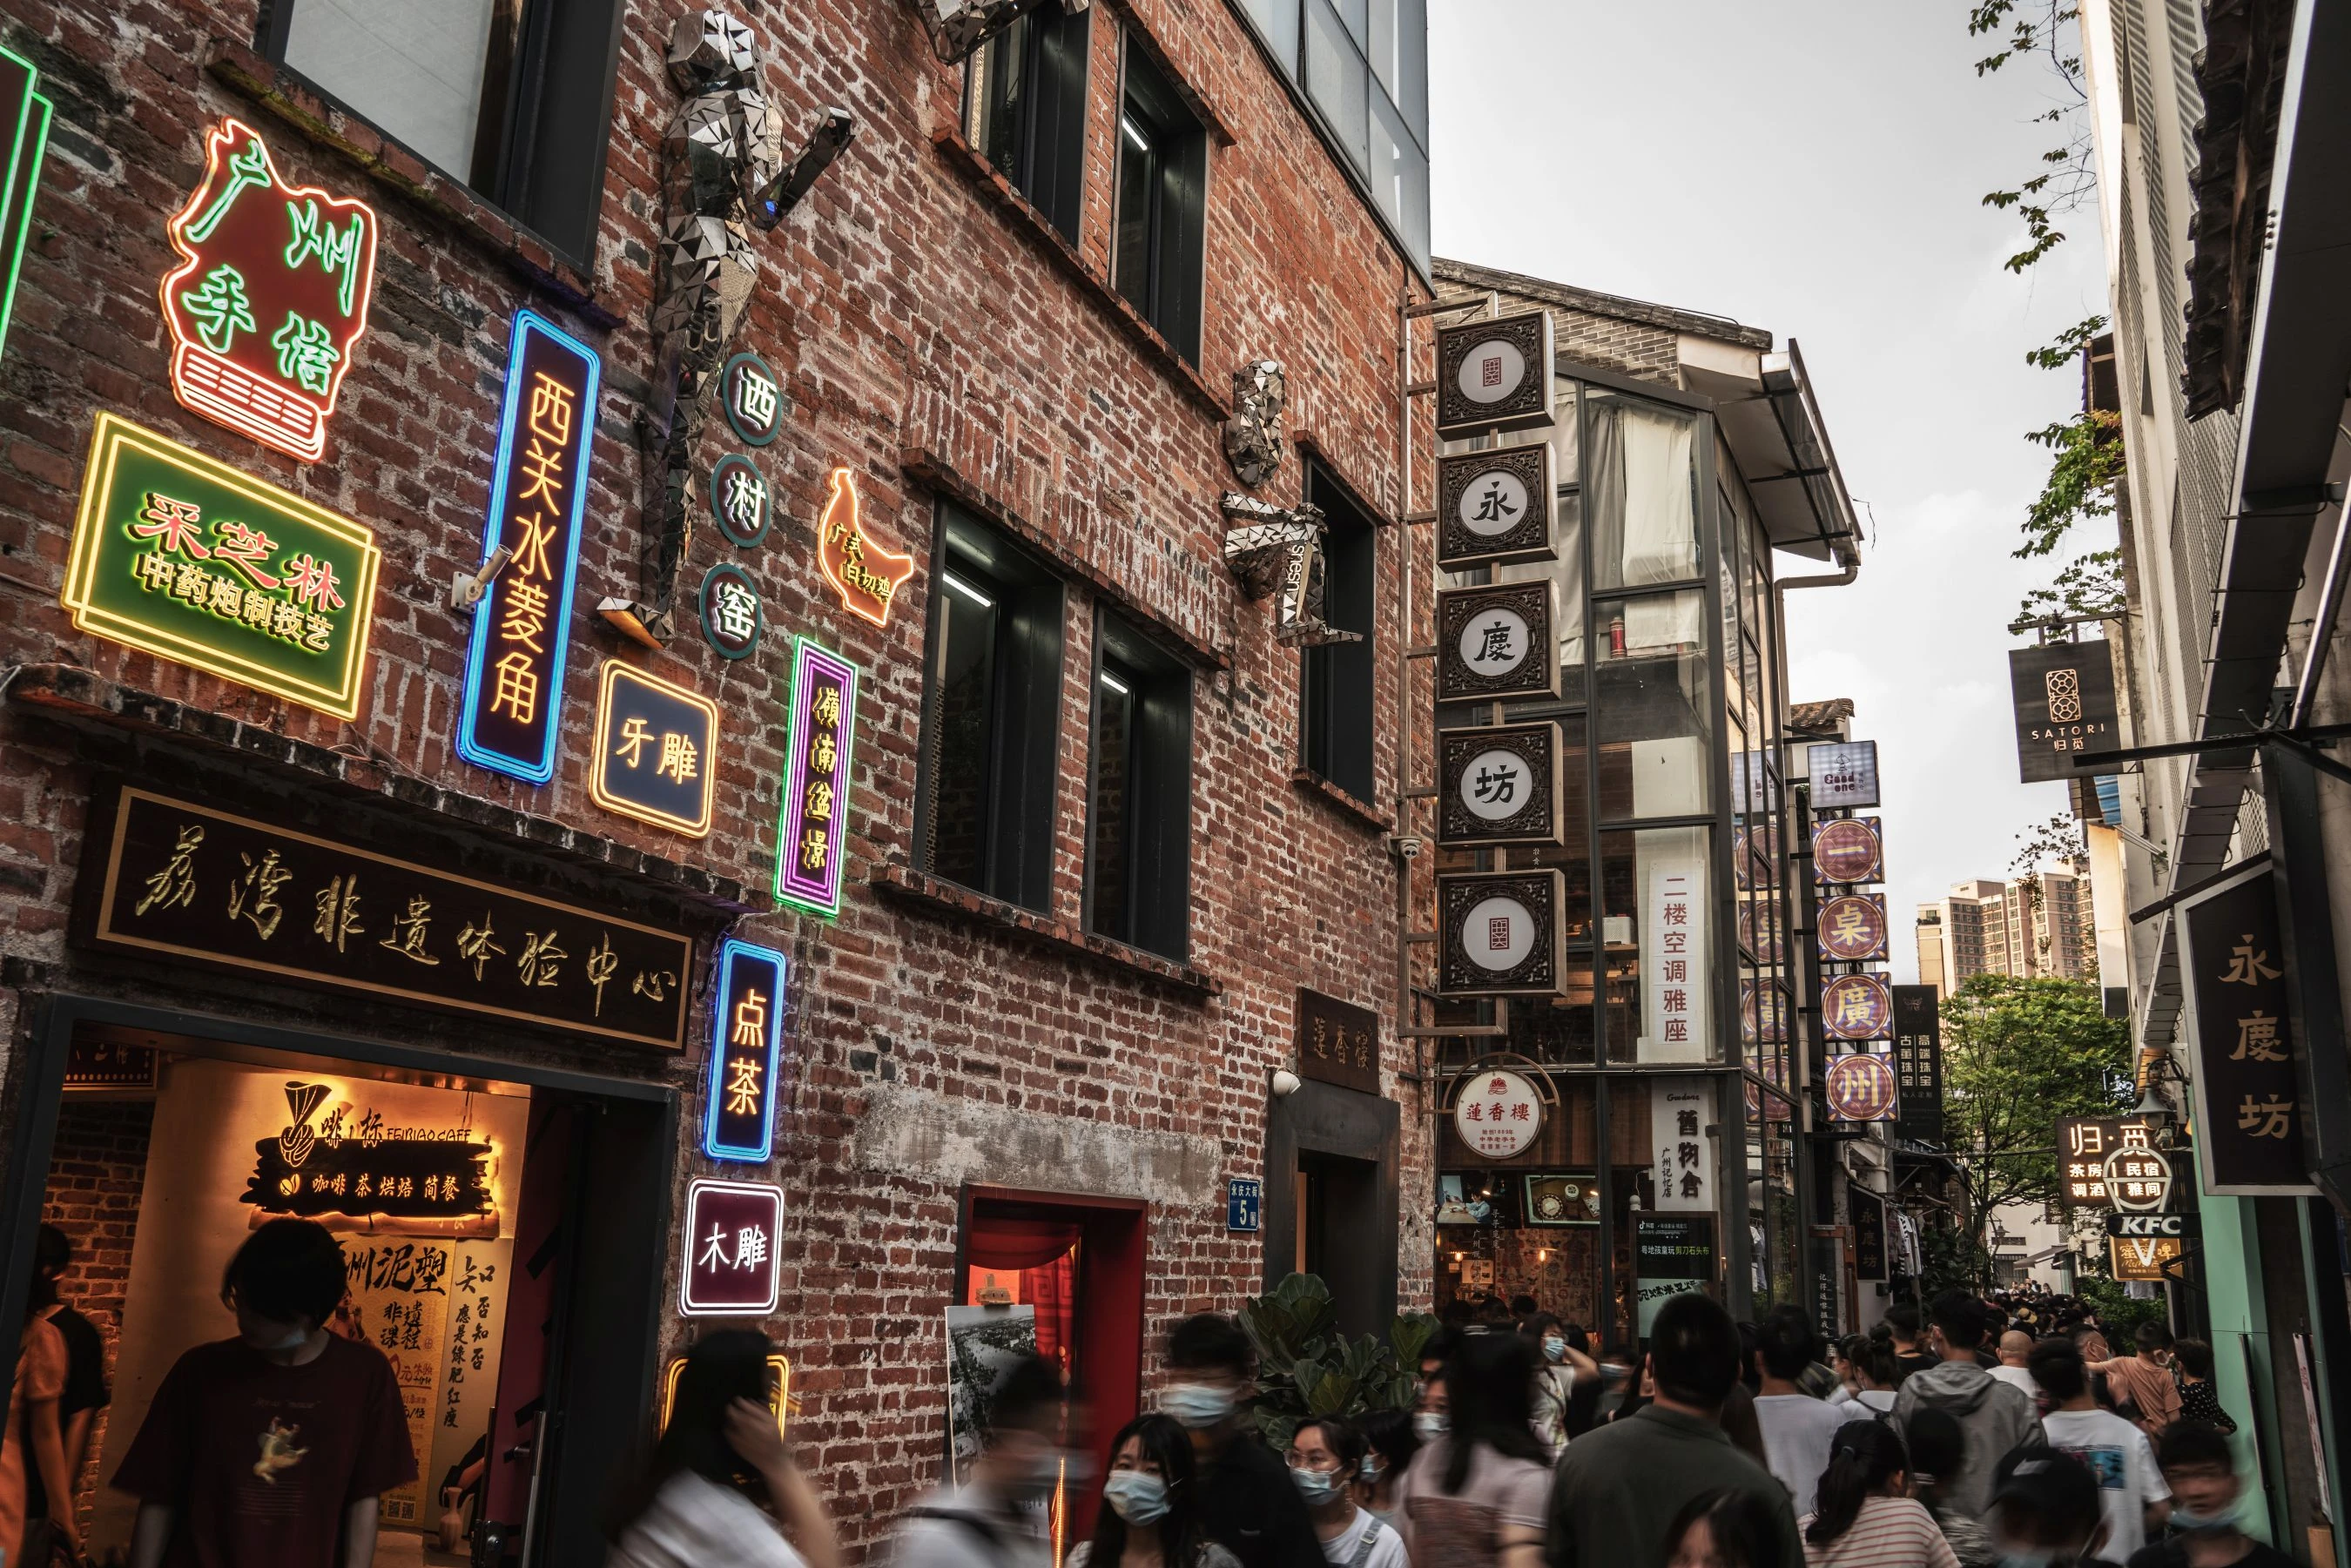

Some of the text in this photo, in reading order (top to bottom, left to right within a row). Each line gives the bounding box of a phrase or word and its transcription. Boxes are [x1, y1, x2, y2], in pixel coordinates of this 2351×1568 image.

[716, 367, 778, 642] 西村窑
[126, 491, 346, 612] 采芝林
[489, 371, 576, 725] 西关水菱角
[826, 522, 865, 562] 广式
[1286, 544, 1305, 592] snesn
[139, 550, 333, 651] 中药炮制技艺
[1470, 481, 1519, 804] 永慶坊
[615, 717, 697, 785] 牙雕
[2031, 723, 2105, 740] SATORI
[2053, 736, 2085, 752] 归觅
[805, 686, 840, 870] 嶺南盆景
[1662, 877, 1688, 1043] 二楼空调雅座
[1827, 845, 1879, 1109] 一桌廣州
[726, 988, 767, 1118] 点茶
[1900, 1034, 1914, 1087] 古董珠宝
[1918, 1034, 1932, 1087] 高端珠宝
[2218, 933, 2294, 1141] 永慶坊
[1465, 1102, 1531, 1122] 蓮香樓
[313, 1173, 461, 1201] 咖啡 茶 烘焙 简餐
[1230, 1182, 1258, 1197] 永庆大街
[1661, 1147, 1673, 1198] 广州记忆店
[2069, 1162, 2159, 1178] 茶房 民宿
[2071, 1181, 2161, 1197] 调酒 雅间
[1240, 1199, 1247, 1225] 5
[2119, 1215, 2182, 1235] KFC
[342, 1242, 448, 1295] 州泥塑
[698, 1221, 768, 1275] 木雕
[455, 1255, 496, 1371] 知否知否
